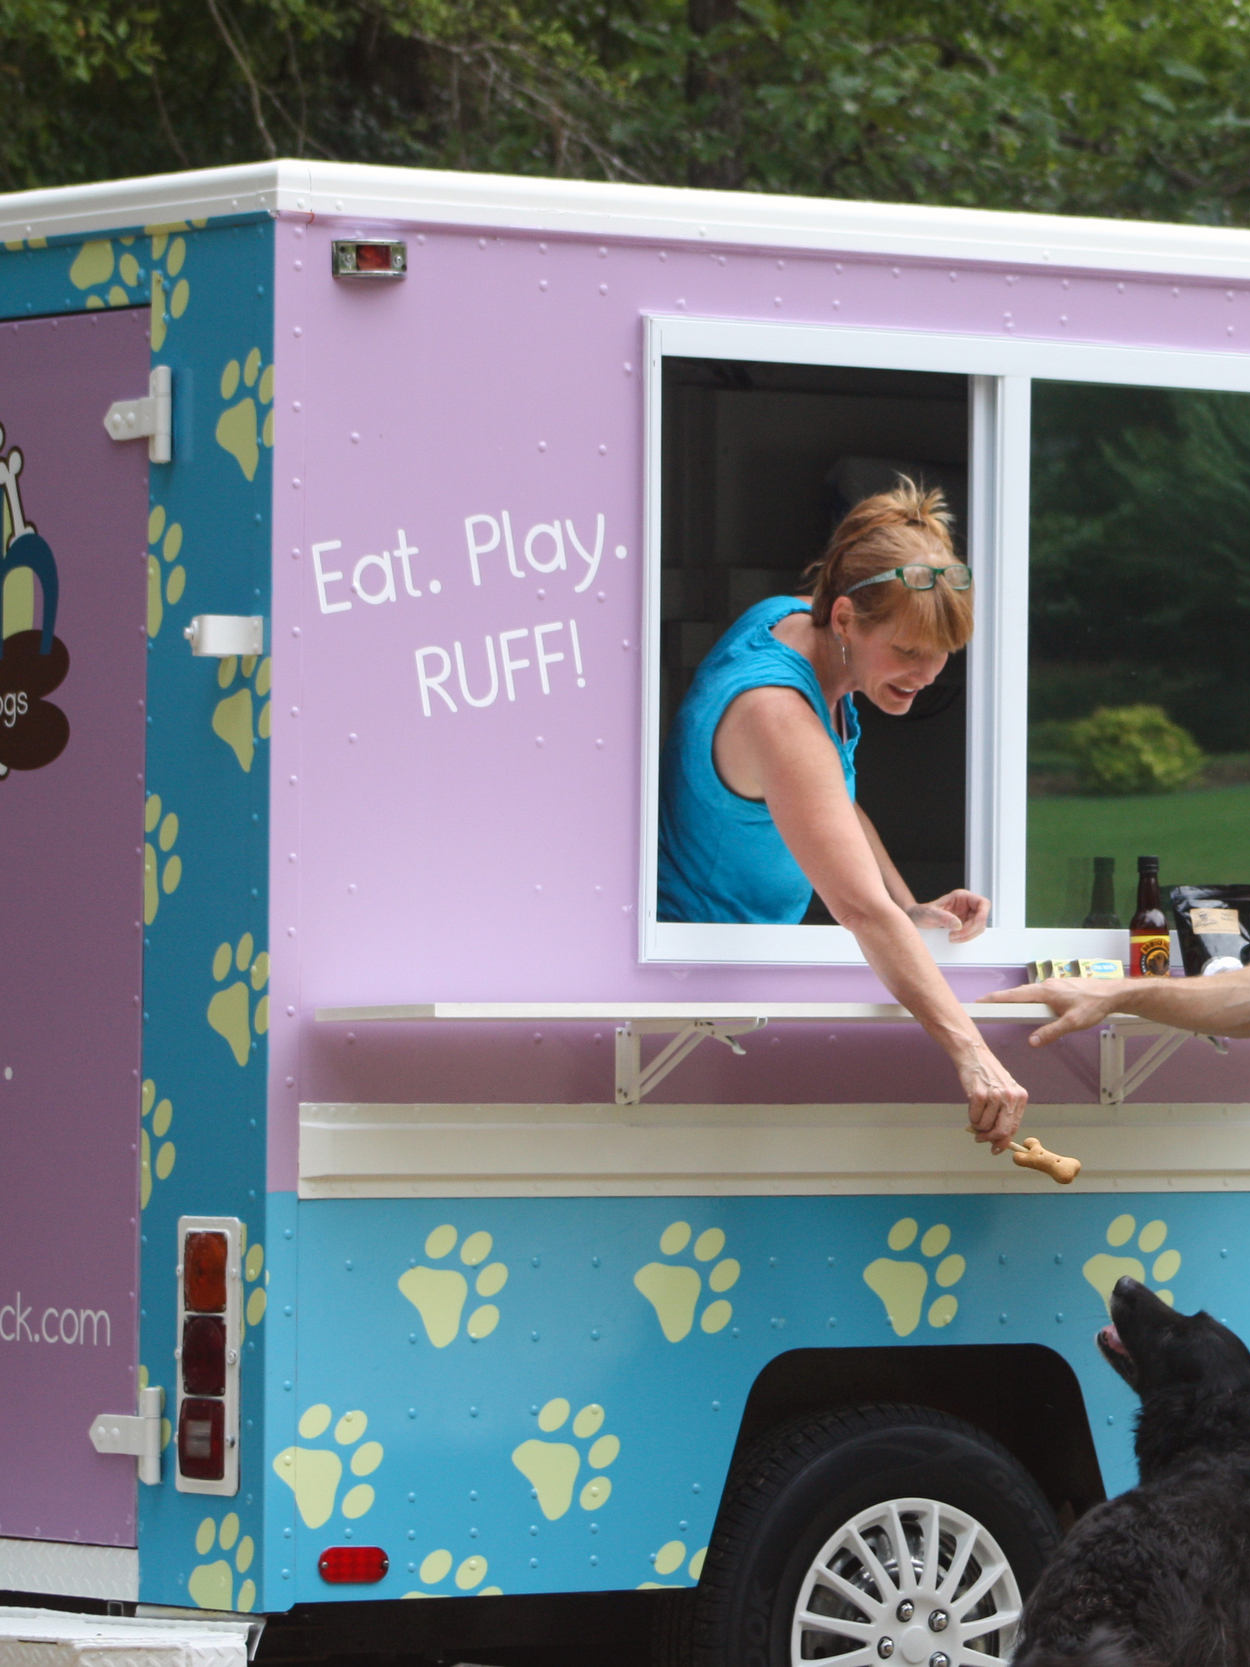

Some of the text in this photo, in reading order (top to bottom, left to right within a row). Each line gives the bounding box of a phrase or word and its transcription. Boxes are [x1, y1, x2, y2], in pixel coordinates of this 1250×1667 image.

[311, 509, 628, 615] Eat. Play.
[414, 619, 587, 718] RUFF!
